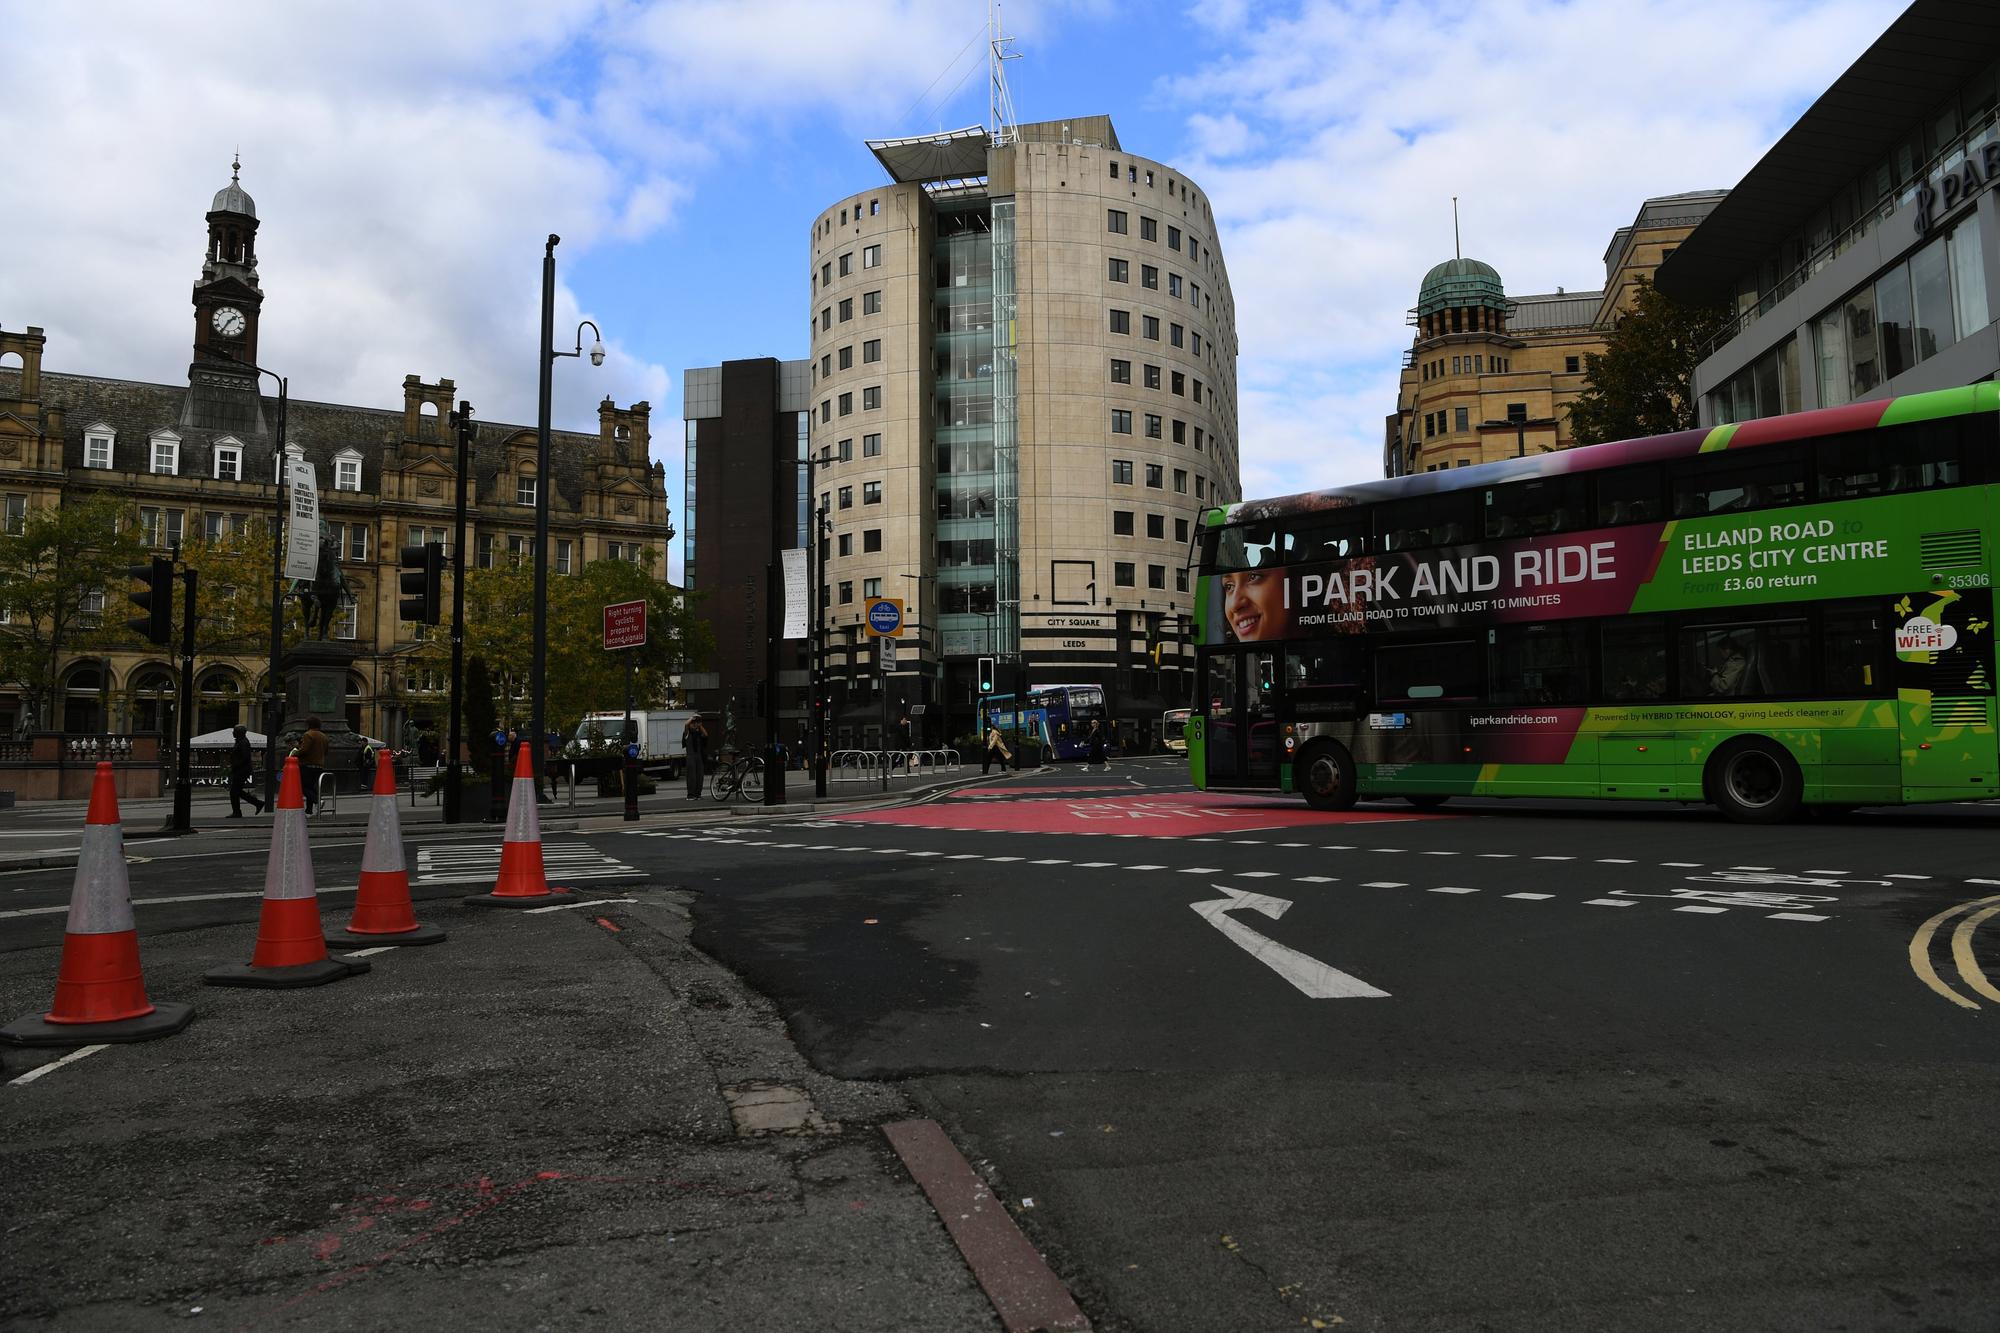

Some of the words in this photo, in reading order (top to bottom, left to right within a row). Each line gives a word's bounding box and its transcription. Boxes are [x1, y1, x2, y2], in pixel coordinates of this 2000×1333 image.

[1684, 527, 1763, 551] ELLAND
[1770, 519, 1835, 542] ROAD
[1842, 519, 1863, 535] to
[1682, 552, 1743, 575] LEEDS
[1750, 547, 1797, 569] CITY
[1803, 540, 1888, 564] CENTRE
[1283, 577, 1290, 609] I
[1301, 565, 1400, 608] PARK
[1410, 554, 1500, 598] AND
[1515, 541, 1617, 588] RIDE
[1948, 574, 1989, 588] 35306
[1682, 581, 1720, 595] From
[1723, 576, 1764, 592] £3.60
[1768, 572, 1817, 588] return
[608, 608, 622, 618] Right
[623, 606, 642, 615] turning
[1299, 615, 1327, 626] FROM
[1327, 611, 1366, 624] ELLAND
[1366, 609, 1396, 621] ROAD
[1396, 608, 1409, 619] TO
[1412, 605, 1446, 617] TOWN
[1447, 603, 1458, 614] IN
[1460, 600, 1488, 613] JUST
[1491, 598, 1507, 610] 10
[1508, 594, 1561, 609] MINUTES
[615, 616, 634, 626] cyclists
[1069, 619, 1100, 627] SQUARE
[610, 627, 631, 636] prepare
[631, 624, 640, 632] for
[1907, 625, 1932, 634] FREE
[1898, 634, 1942, 648] Wi-Fi
[1470, 714, 1558, 726] iparkandride.com
[1594, 712, 1629, 721] Powered
[1630, 712, 1640, 722] by
[1642, 711, 1673, 720] HYBRID
[1674, 710, 1736, 720] TECHNOLOGY,
[1738, 710, 1766, 720] giving
[1769, 708, 1794, 718] Leeds
[1796, 707, 1829, 717] cleaner
[1832, 707, 1845, 716] air
